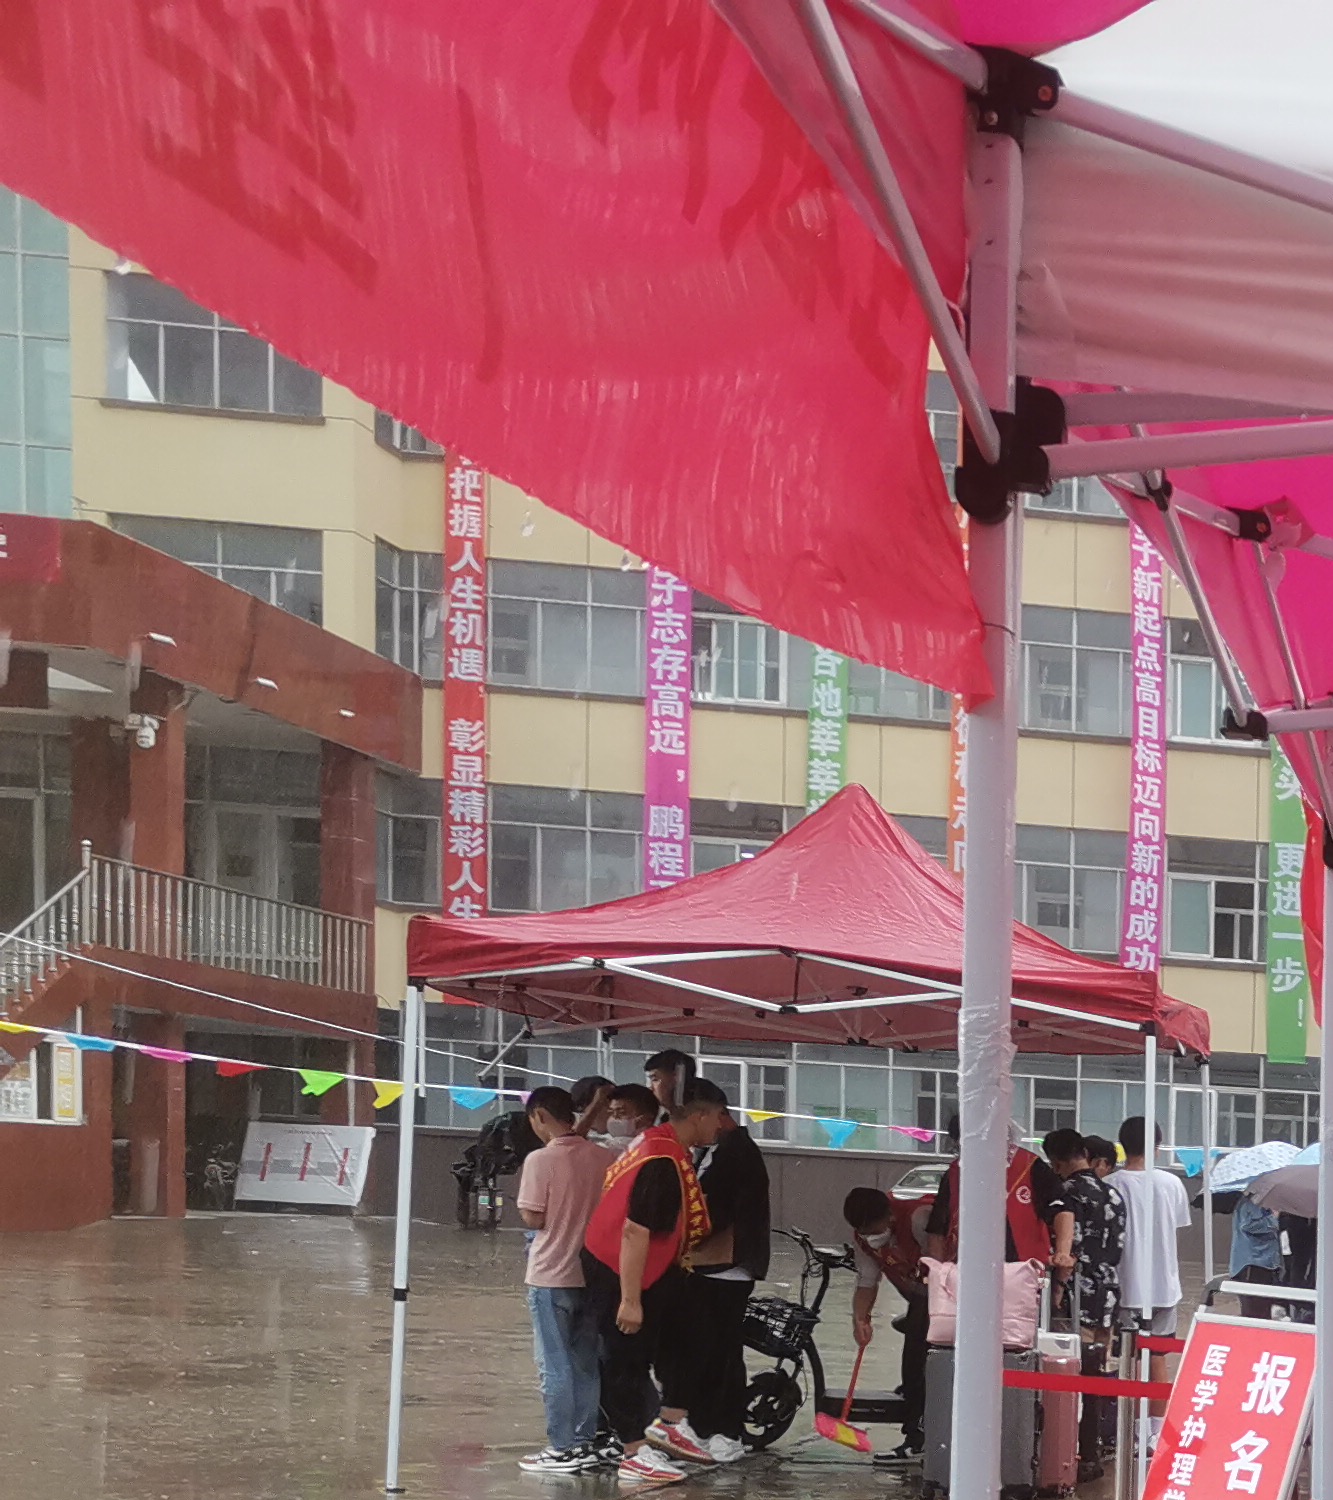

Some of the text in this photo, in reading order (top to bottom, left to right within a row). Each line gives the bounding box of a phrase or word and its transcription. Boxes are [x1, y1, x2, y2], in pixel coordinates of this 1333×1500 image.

[448, 455, 485, 919] 把握人生机遇，彰显精彩人生
[648, 568, 687, 889] 子志存高远，鹏程
[808, 646, 843, 815] 各地莘莘
